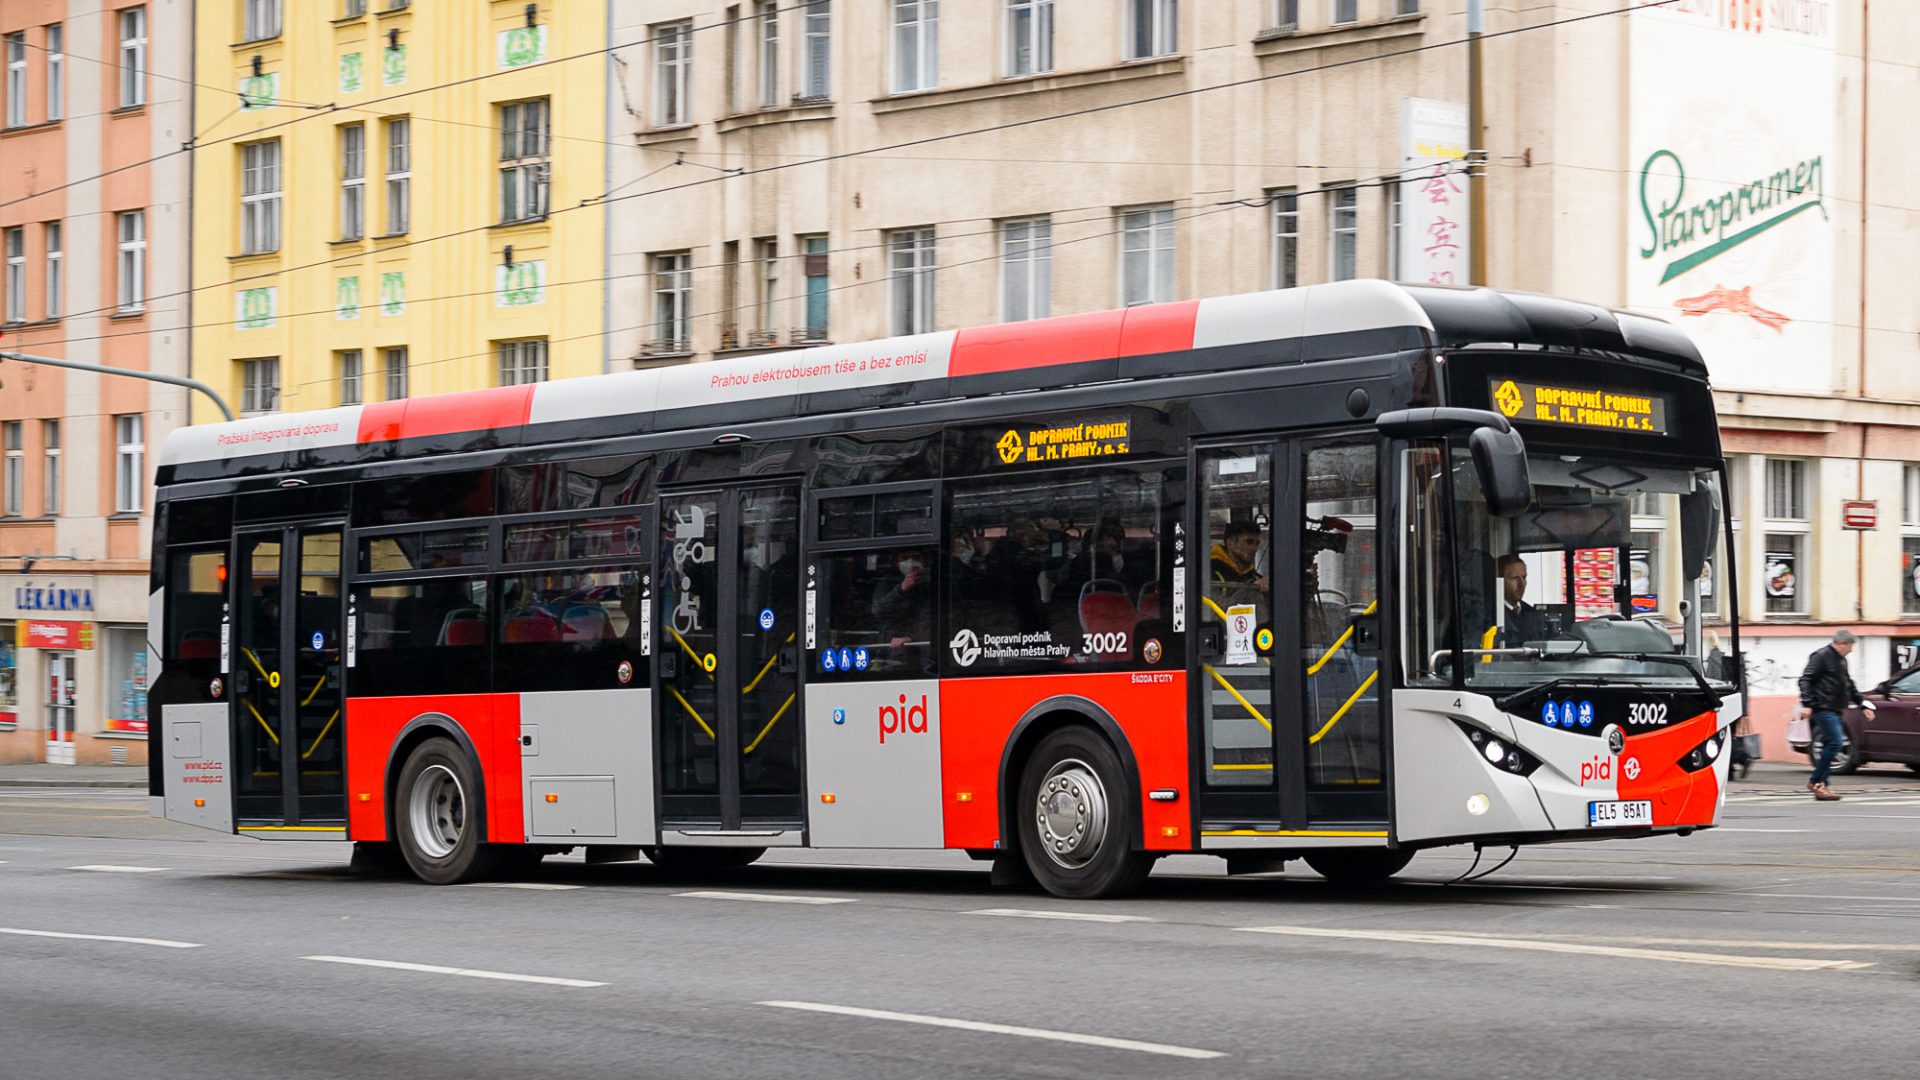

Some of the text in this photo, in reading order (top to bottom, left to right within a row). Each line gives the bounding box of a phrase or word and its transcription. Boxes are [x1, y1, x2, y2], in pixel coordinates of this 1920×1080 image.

[1640, 150, 1823, 259] Staropramen
[710, 349, 929, 388] Prahou elektrobusem tiše a bez emisí
[1536, 387, 1652, 414] DOPRAVNÍ PODNIK
[1535, 404, 1557, 421] HL.
[1559, 407, 1575, 423] M.
[1577, 408, 1624, 428] PRAHY,
[1641, 418, 1654, 431] s.
[303, 422, 339, 437] doprava
[1029, 422, 1128, 446] DOPRAVNÍ PODNIK
[1026, 441, 1129, 462] HL. M. PRAHY, a. s.
[16, 581, 95, 611] LÉKÁRNA
[984, 632, 1052, 646] Dopravní podnik
[1082, 631, 1127, 654] 3002
[984, 644, 1071, 658] hlavního města Prahy
[1453, 698, 1462, 708] 4
[1628, 703, 1668, 724] 3002
[879, 694, 928, 744] pid
[184, 760, 222, 771] www.pid.cz
[1580, 755, 1611, 787] pid
[1598, 803, 1647, 820] EL5 85AT
